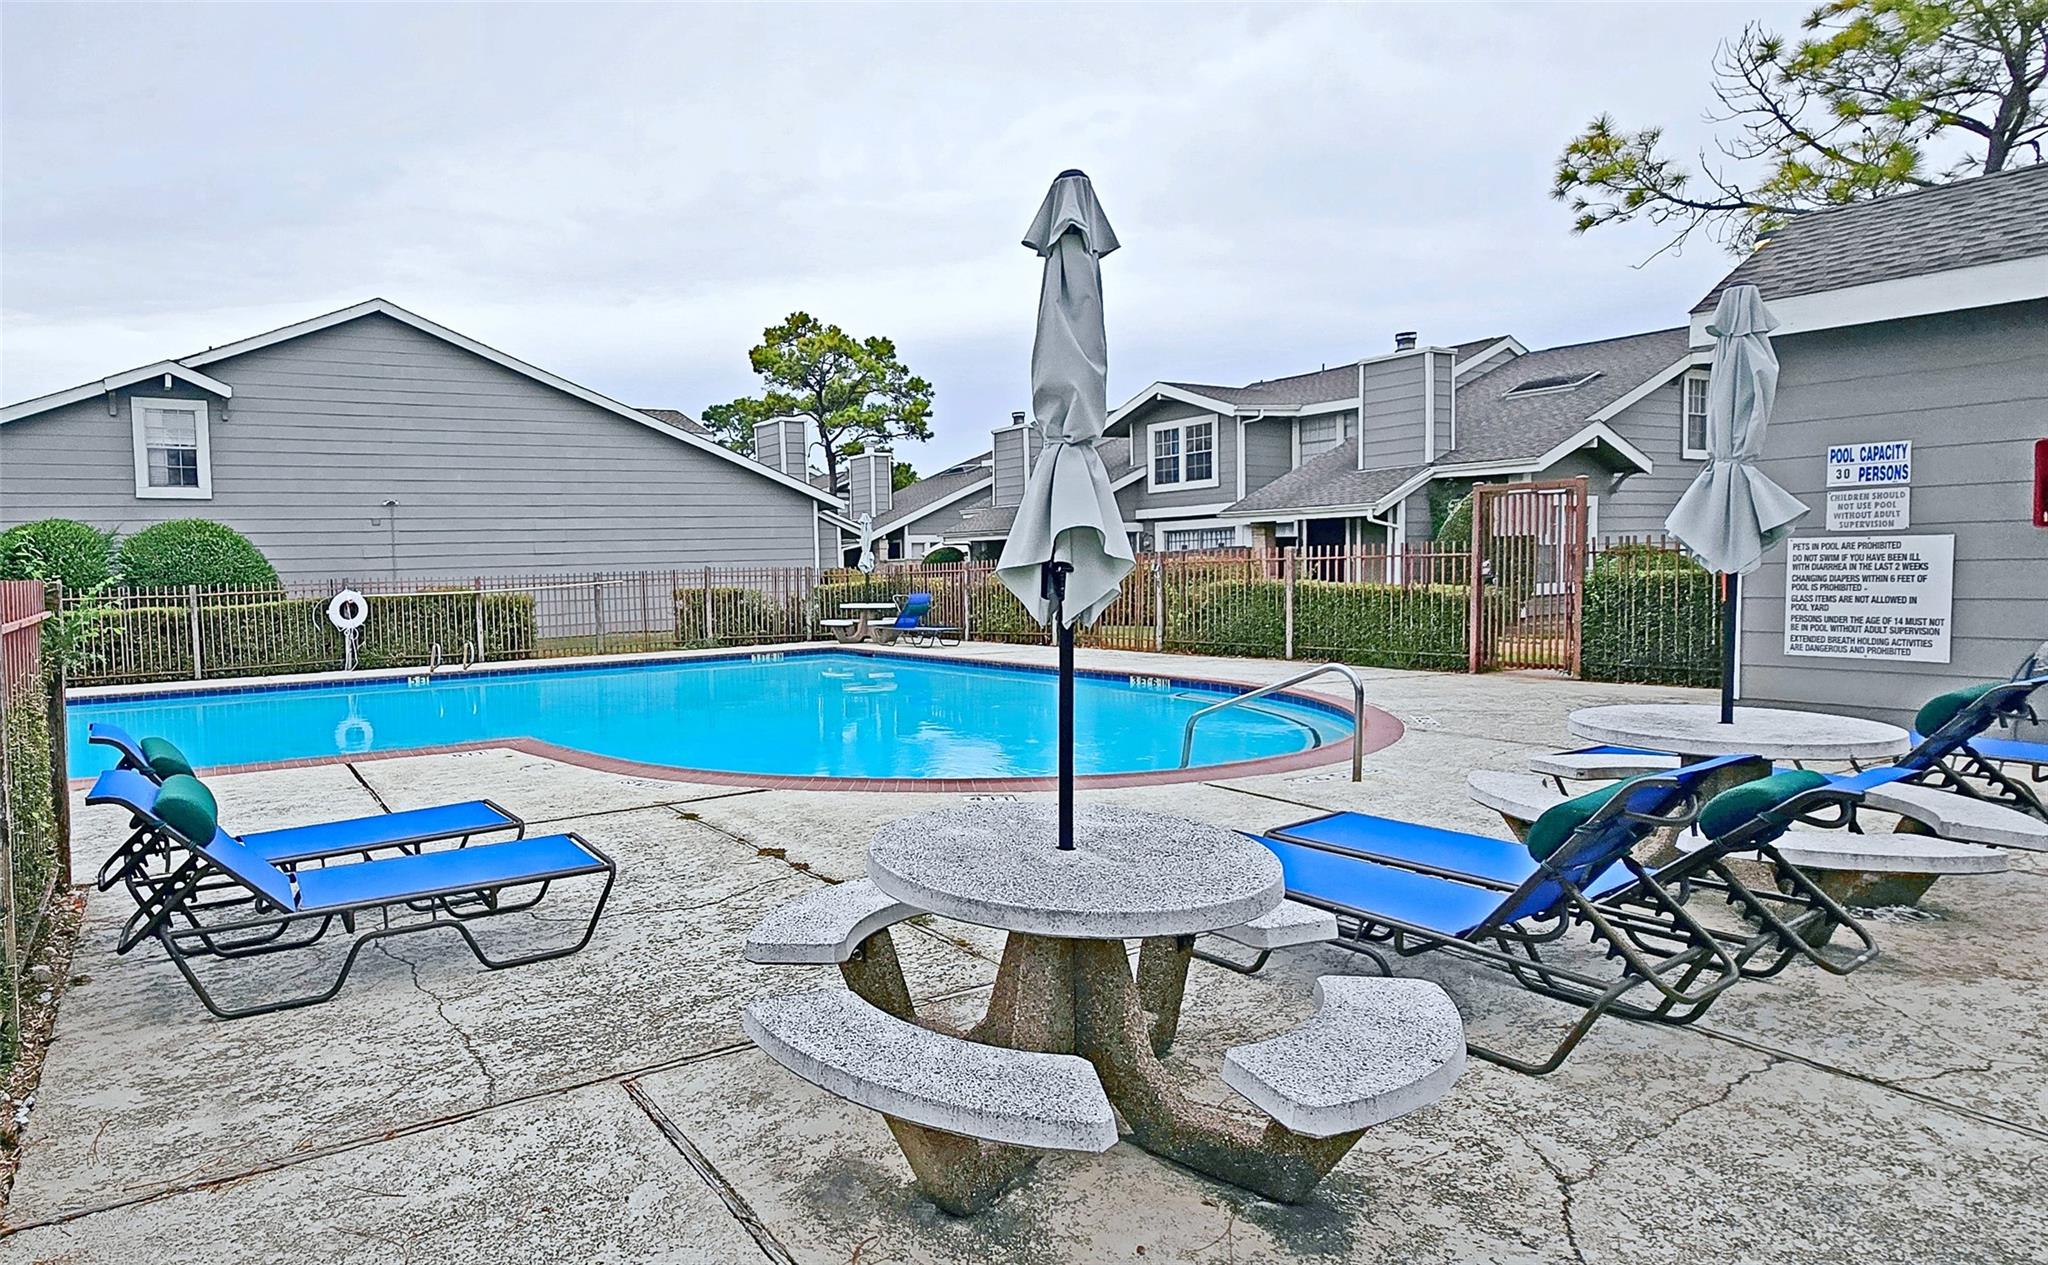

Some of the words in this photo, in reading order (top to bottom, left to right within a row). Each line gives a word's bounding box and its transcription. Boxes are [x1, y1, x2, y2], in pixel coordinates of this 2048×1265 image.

[1830, 448, 1854, 463] POOL
[1860, 444, 1908, 462] CAPACITY
[1836, 469, 1850, 479] 30
[1858, 464, 1908, 482] PERSONS
[1831, 493, 1869, 501] CHILDREN
[1872, 491, 1905, 500] SHOULD
[1839, 520, 1894, 528] SUPERVISION
[1857, 541, 1901, 549] PROHIBITED
[1889, 627, 1940, 635] SUPERVISION
[1857, 637, 1889, 646] HOLDING
[1891, 639, 1933, 647] ACTIVITIES
[1867, 647, 1911, 655] PROHIBITED
